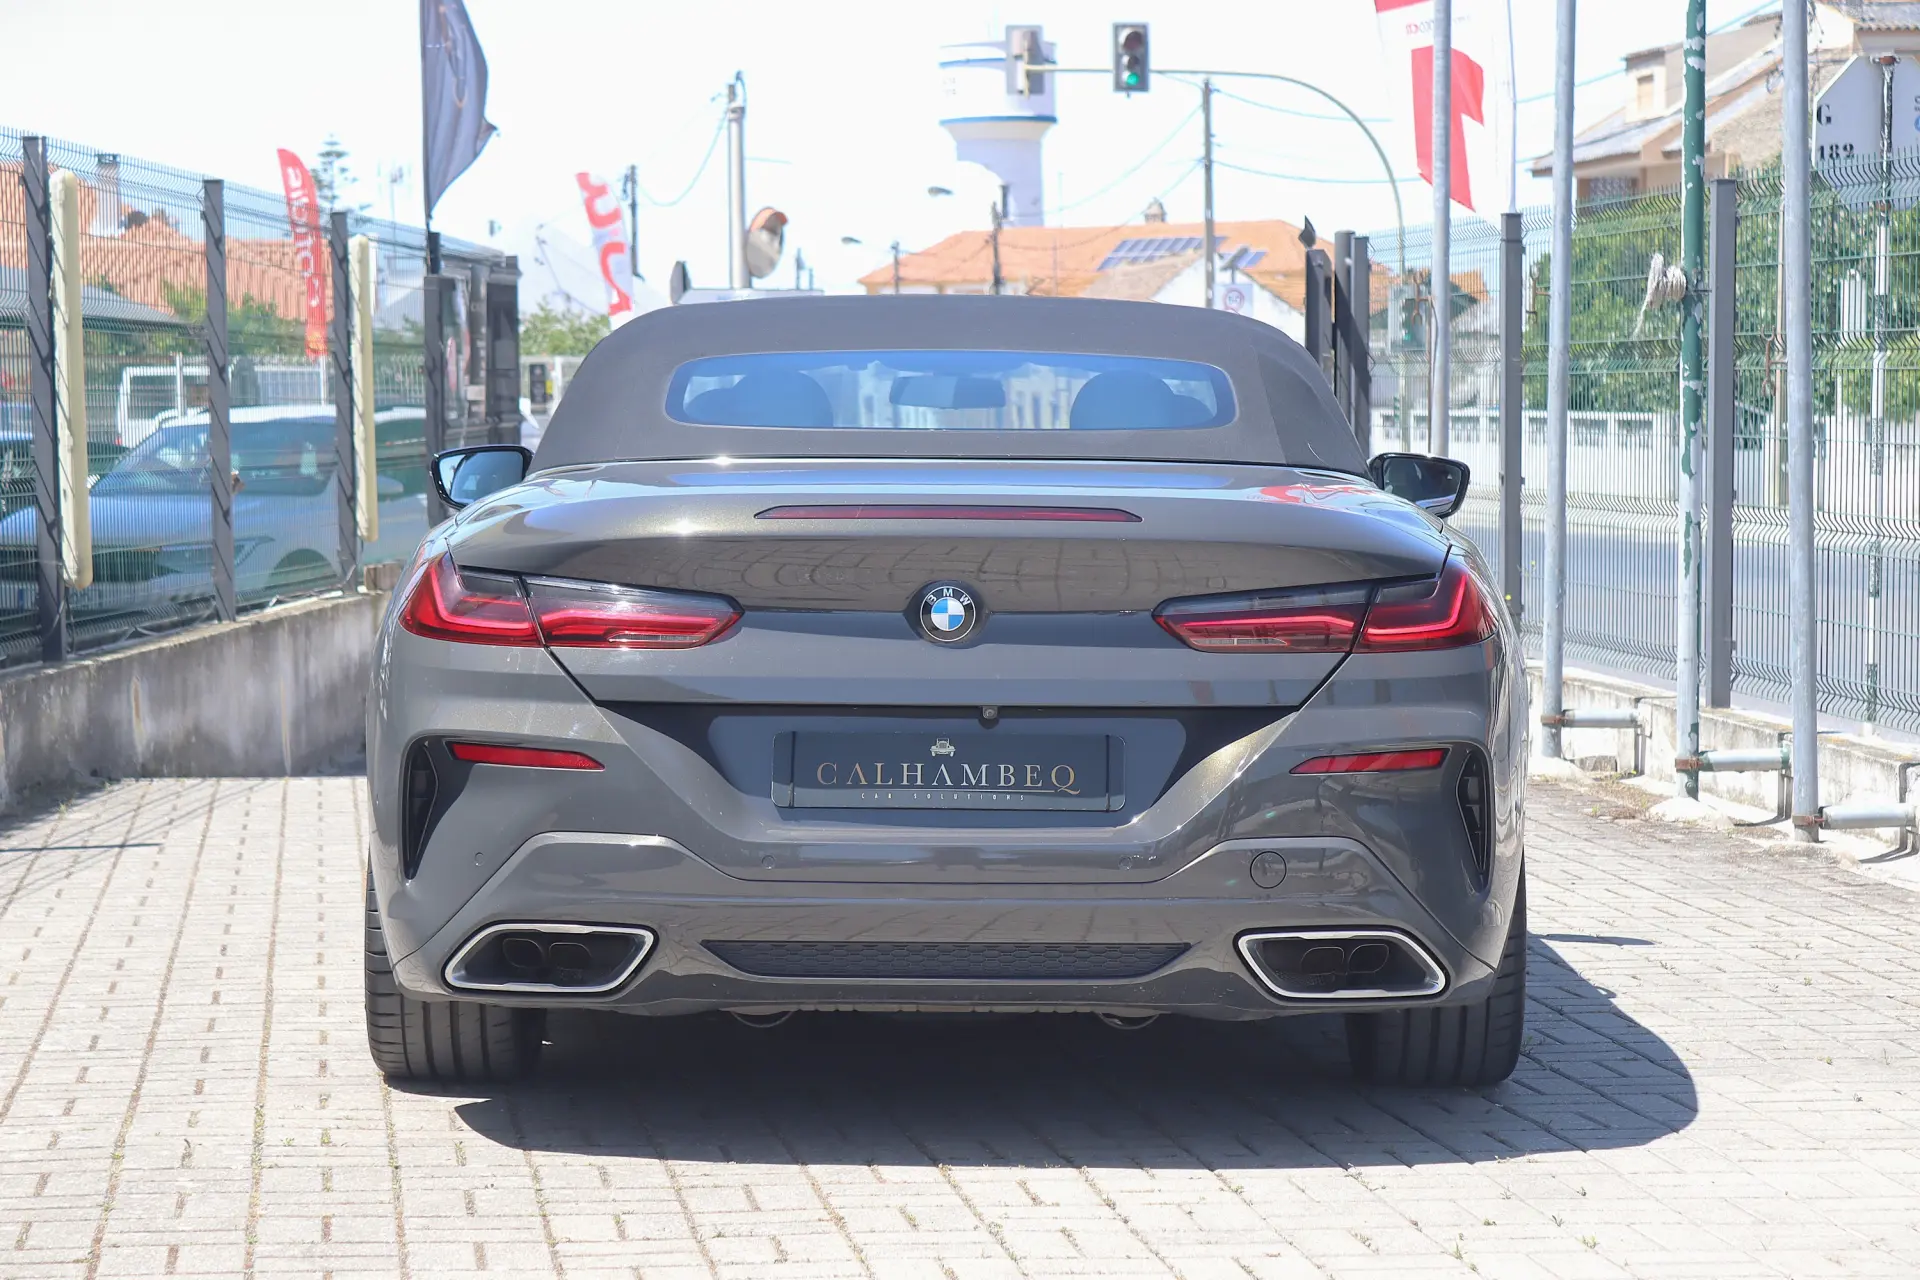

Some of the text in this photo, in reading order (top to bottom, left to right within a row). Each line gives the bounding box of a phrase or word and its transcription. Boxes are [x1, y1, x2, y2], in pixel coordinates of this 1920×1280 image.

[926, 588, 971, 606] BMW
[816, 762, 1081, 795] CALHAMBEQ
[861, 792, 892, 800] CAR
